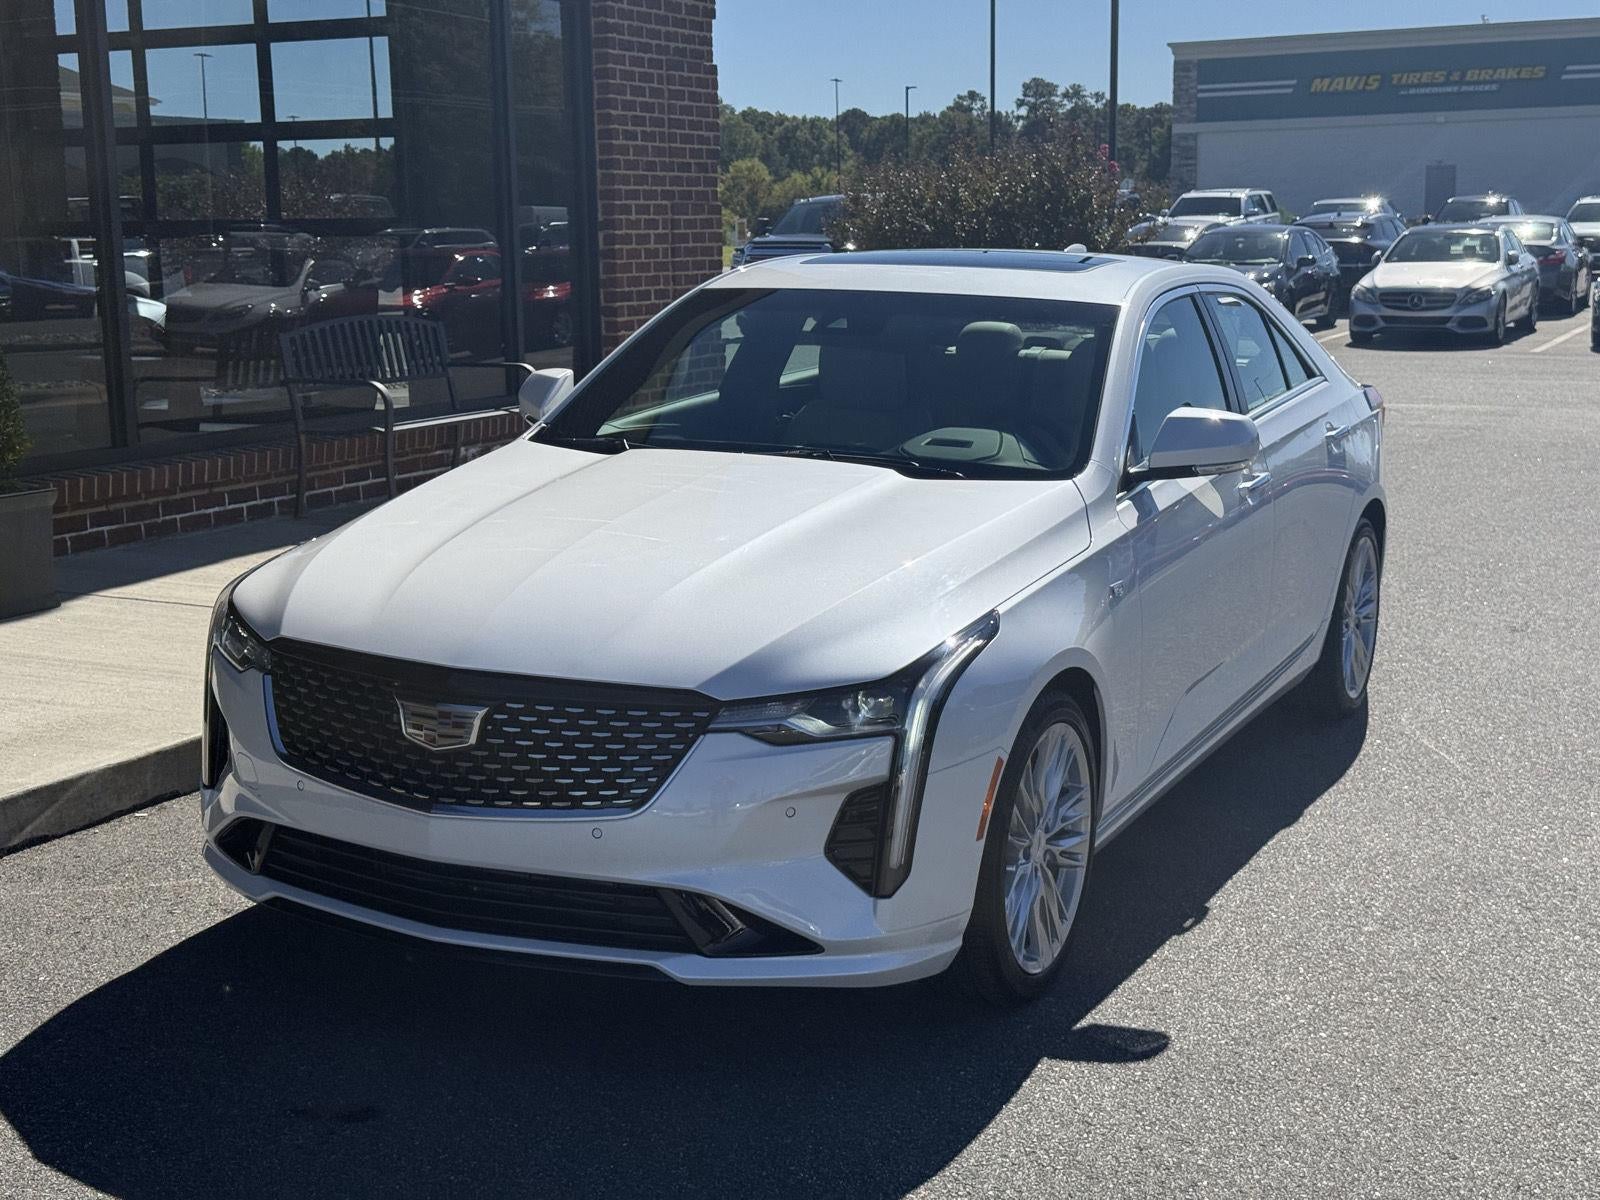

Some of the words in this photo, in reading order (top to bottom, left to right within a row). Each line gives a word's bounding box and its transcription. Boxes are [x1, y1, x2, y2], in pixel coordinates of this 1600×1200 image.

[1310, 75, 1381, 93] MAVIS
[1391, 71, 1447, 85] TIRES
[1466, 66, 1546, 81] BRAKES
